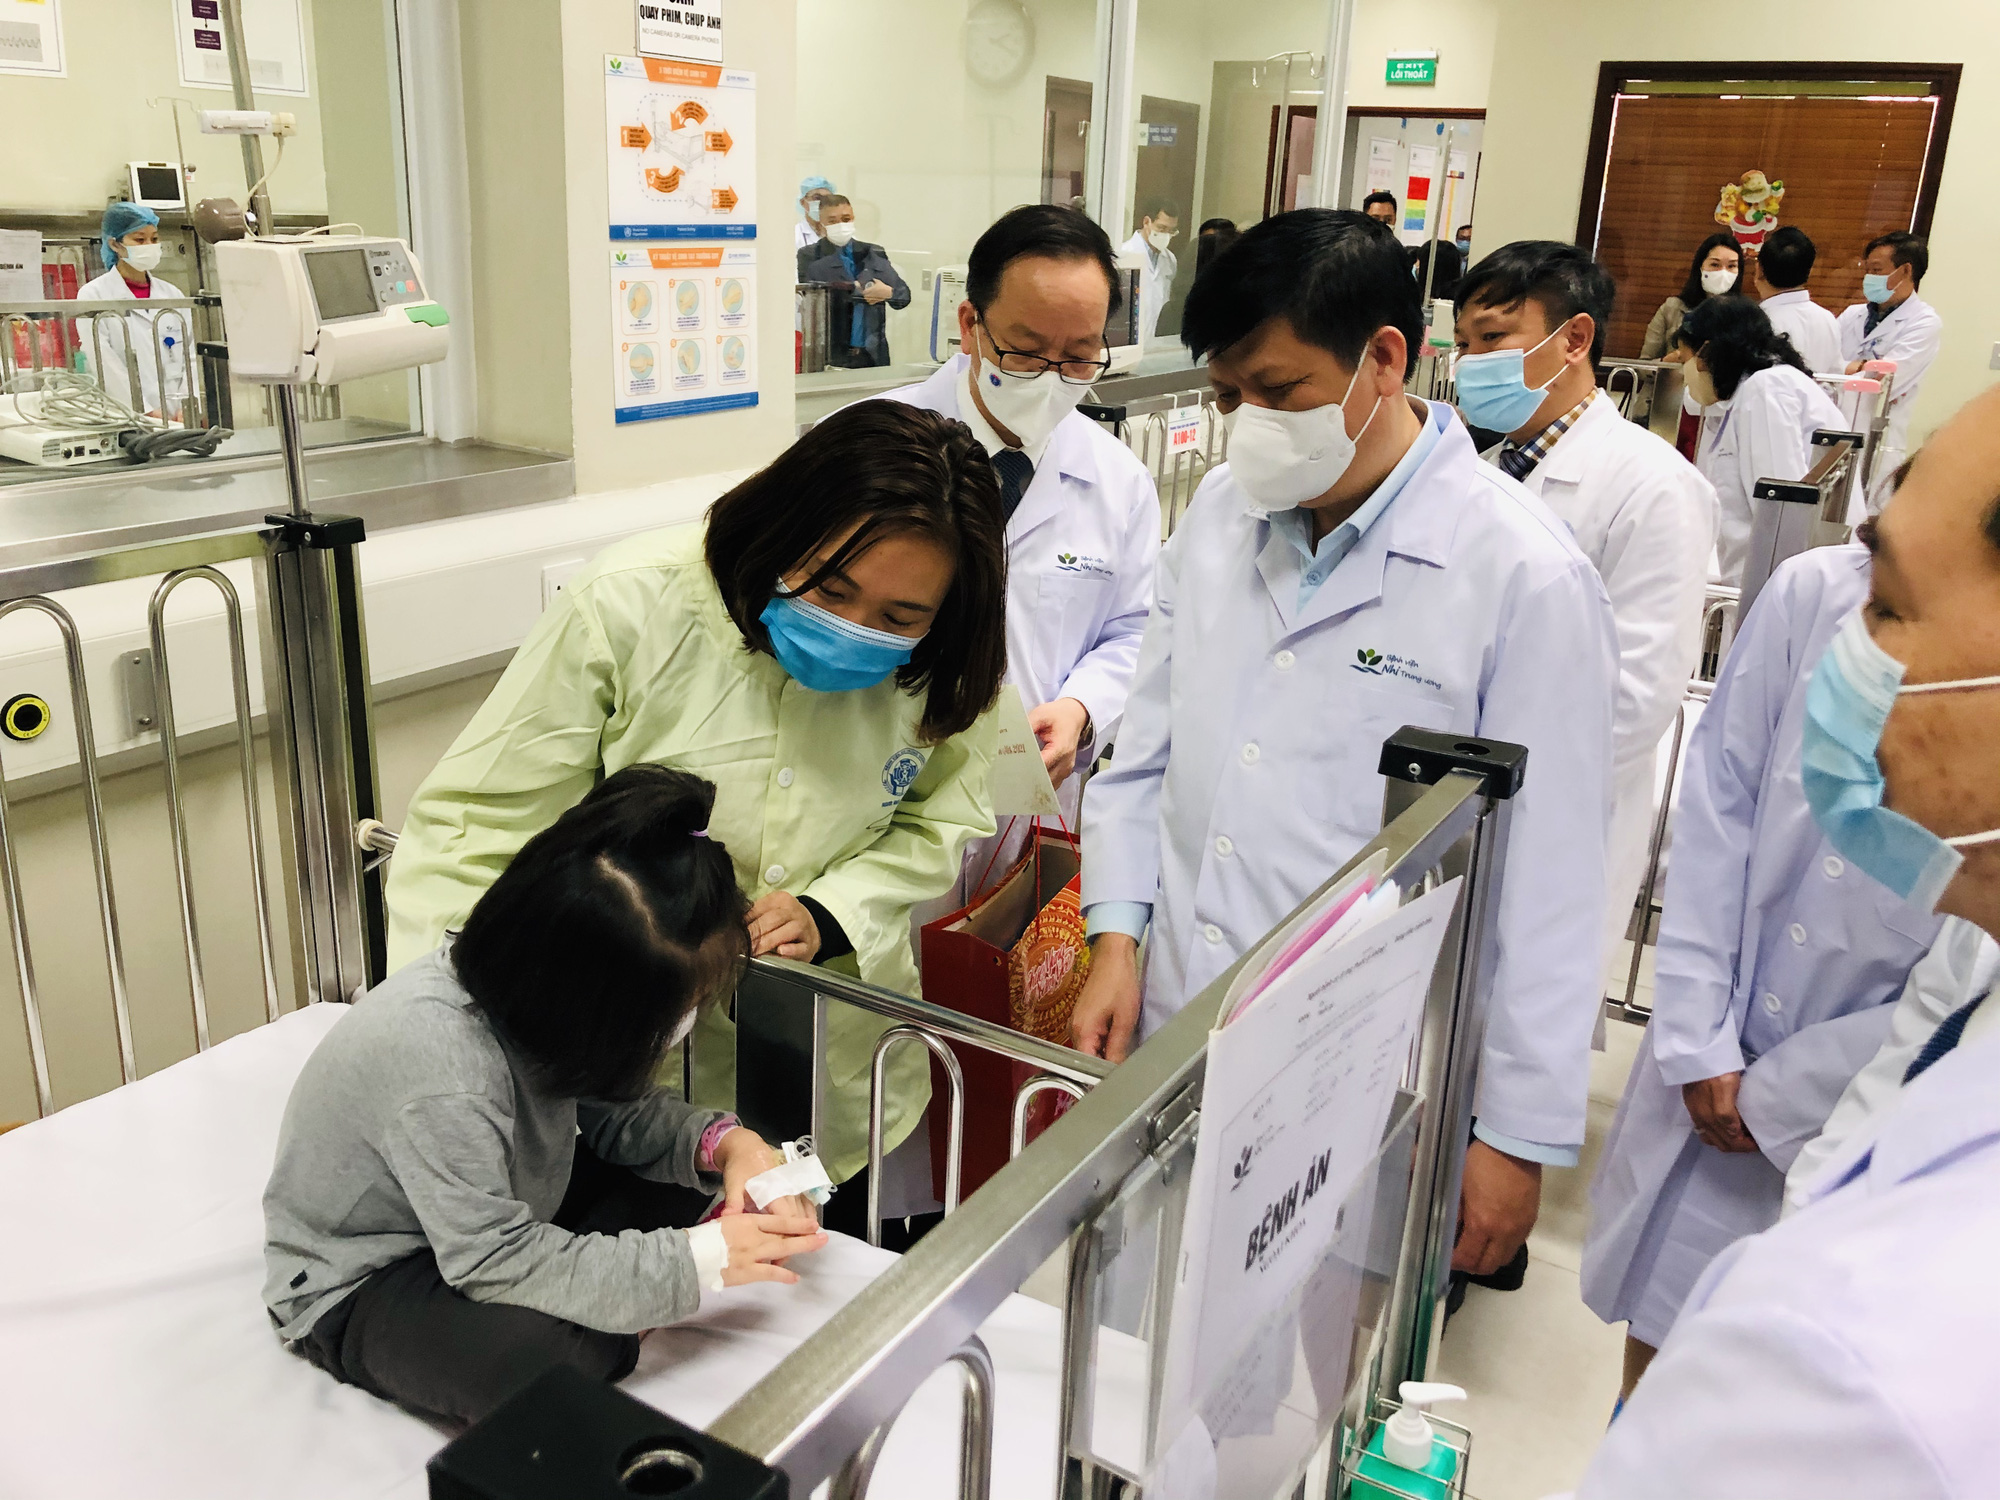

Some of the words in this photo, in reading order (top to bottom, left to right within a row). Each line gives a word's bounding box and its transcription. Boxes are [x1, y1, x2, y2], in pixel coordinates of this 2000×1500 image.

[640, 4, 659, 20] QUAY
[661, 8, 683, 25] PHIM,
[685, 12, 705, 29] CHỤP
[707, 13, 721, 30] ẢNH
[650, 28, 673, 38] CAMERAS
[681, 33, 701, 41] CAMERA
[701, 36, 720, 44] PHONES
[1404, 68, 1428, 79] THOÁT
[675, 111, 684, 125] 2
[622, 130, 629, 145] 1
[705, 135, 712, 149] 4
[648, 171, 655, 184] 3
[1173, 428, 1196, 445] A100-12
[1382, 664, 1401, 676] Nhi
[1401, 670, 1422, 684] Trung
[1244, 1180, 1300, 1272] BỆNH
[1301, 1147, 1332, 1207] ÁN
